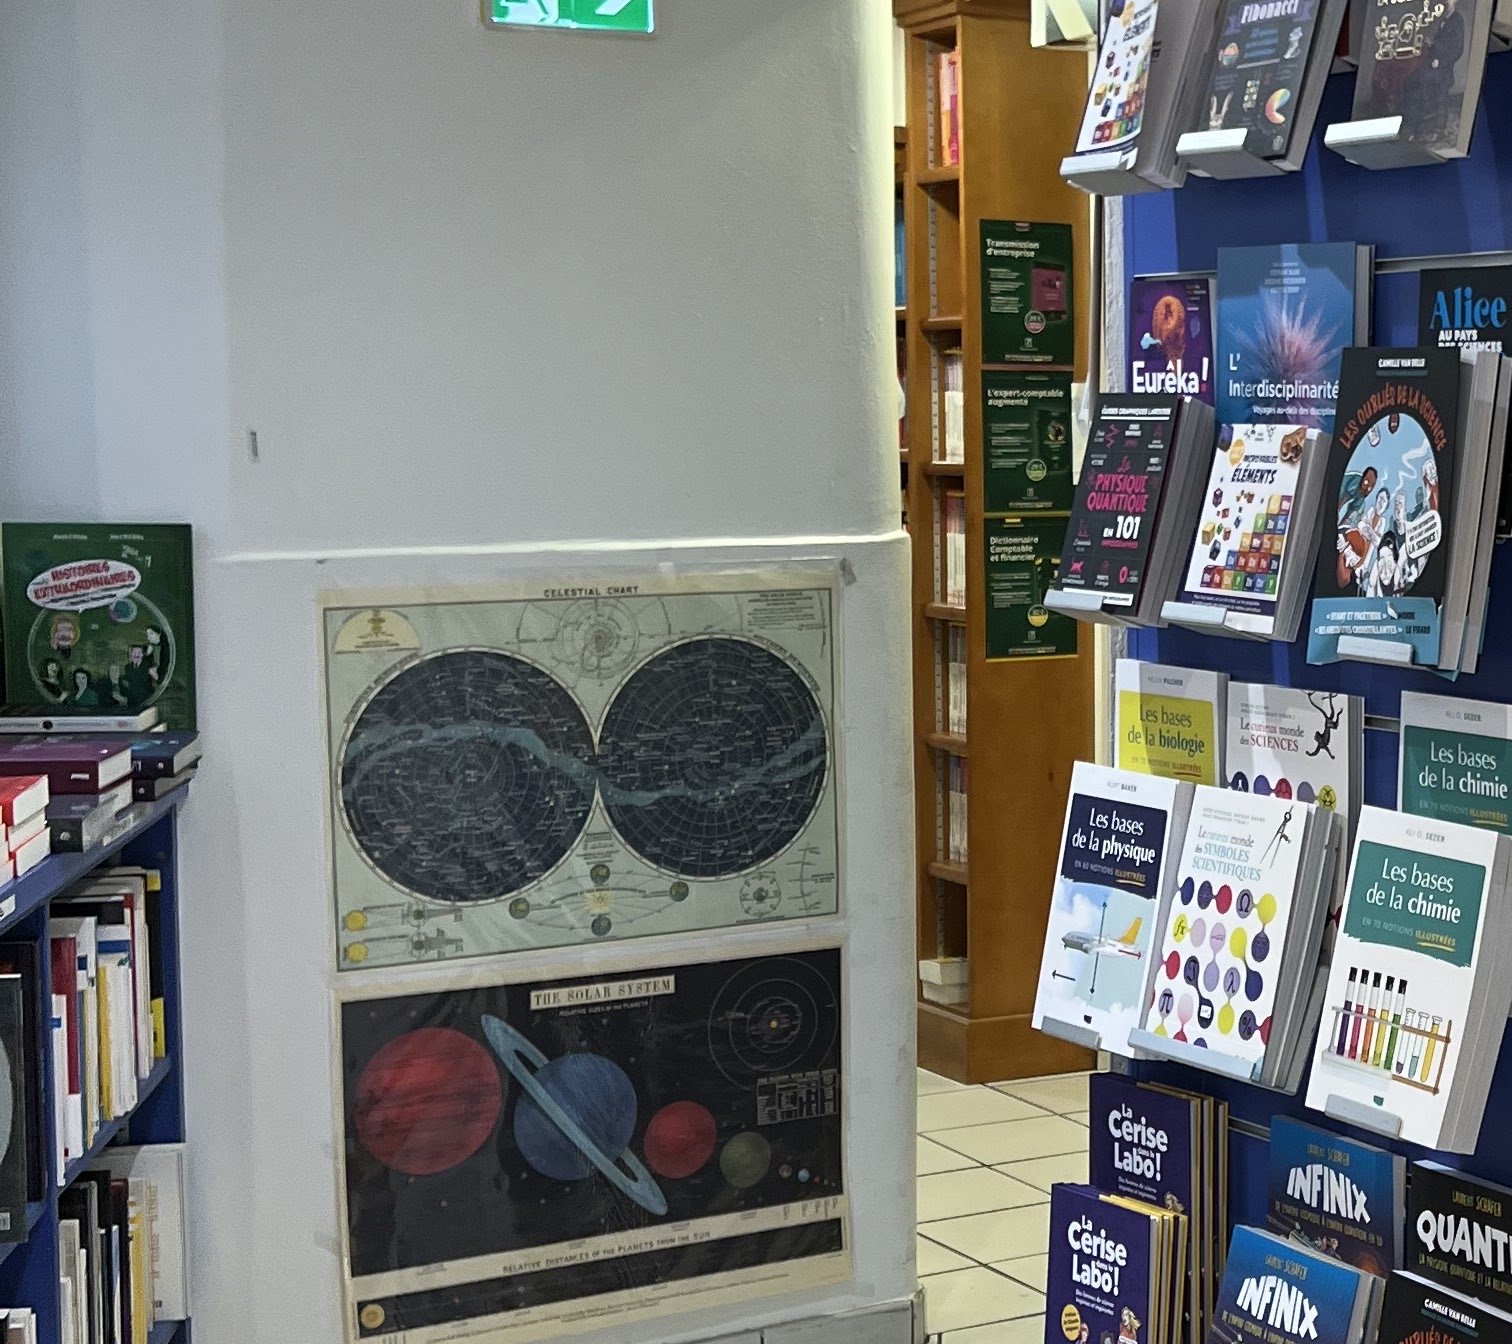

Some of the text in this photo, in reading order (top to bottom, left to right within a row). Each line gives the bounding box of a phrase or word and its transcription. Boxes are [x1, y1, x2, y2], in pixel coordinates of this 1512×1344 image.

[1429, 286, 1508, 330] Alice
[1438, 330, 1478, 341] AU PAYS
[1229, 380, 1339, 400] Interdisciplinarité
[1339, 420, 1360, 450] LES
[1095, 474, 1148, 494] PHYSIQUE
[1231, 464, 1276, 485] ÉLÉMENTS
[1087, 493, 1149, 513] QUANTIQUE
[1116, 515, 1141, 540] 101
[543, 585, 639, 598] CELESTIAL CHART
[1140, 704, 1192, 729] Les bases
[1240, 717, 1305, 739] Le monde
[1127, 725, 1205, 758] de la biologie
[1250, 733, 1299, 753] SCIENCES
[1430, 740, 1497, 771] Les bases
[1418, 764, 1508, 800] de la chimie
[1089, 807, 1145, 837] Les bases
[1071, 824, 1156, 866] de la physique
[1203, 839, 1250, 864] SYMBOLES
[1425, 833, 1445, 844] SEZER
[1191, 855, 1262, 883] SCIENTIFIQUES
[1381, 857, 1454, 894] Les bases
[1365, 881, 1461, 925] de la chimie
[1414, 929, 1456, 947] ILLUSTRÉES
[534, 977, 671, 1007] THE SOLAR SYSTEM
[1122, 1103, 1133, 1119] La
[1108, 1108, 1169, 1153] Cerise
[1114, 1141, 1162, 1182] Labo!
[1286, 1163, 1372, 1224] INFINIX
[1081, 1214, 1093, 1232] La
[618, 1239, 655, 1253] PLANETS
[1067, 1220, 1128, 1267] Cerise
[1071, 1253, 1120, 1297] Labo!
[1236, 1274, 1319, 1341] INFINIX
